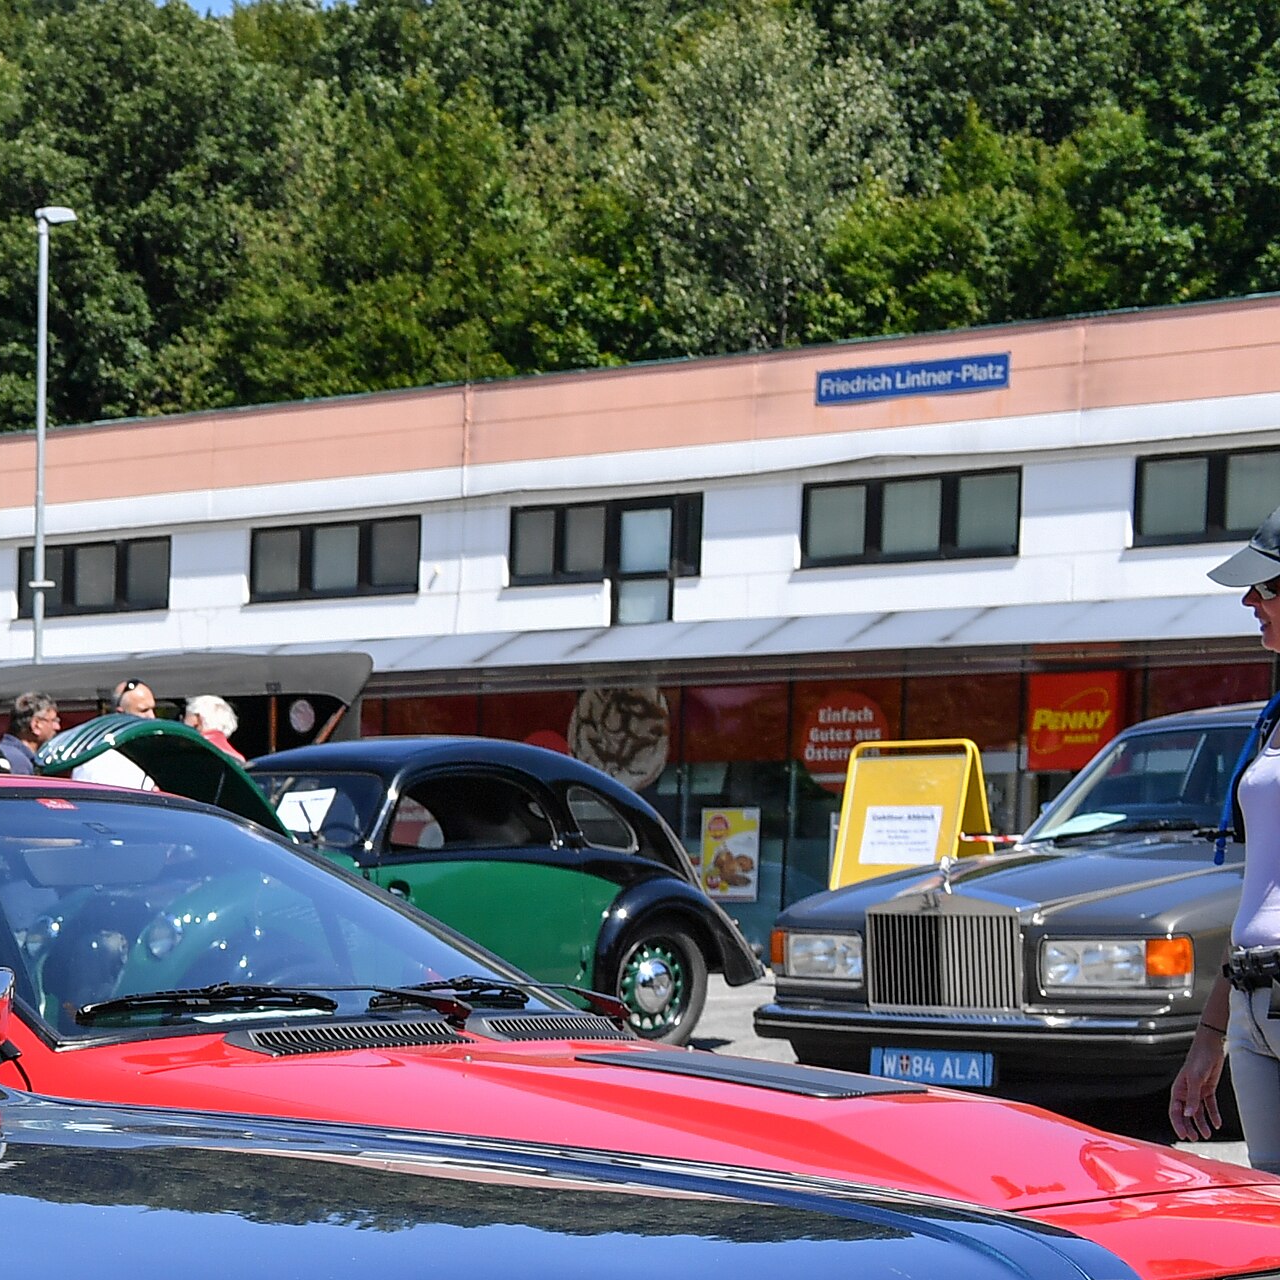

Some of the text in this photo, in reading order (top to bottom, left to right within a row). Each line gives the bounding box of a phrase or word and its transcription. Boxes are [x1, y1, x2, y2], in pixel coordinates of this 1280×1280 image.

[820, 362, 1005, 397] Friedrich Lintner-Platz
[818, 706, 874, 723] Einfach
[1031, 708, 1110, 731] PENNY
[809, 726, 881, 742] Gutes aus
[883, 1054, 981, 1080] W 84 ALA
